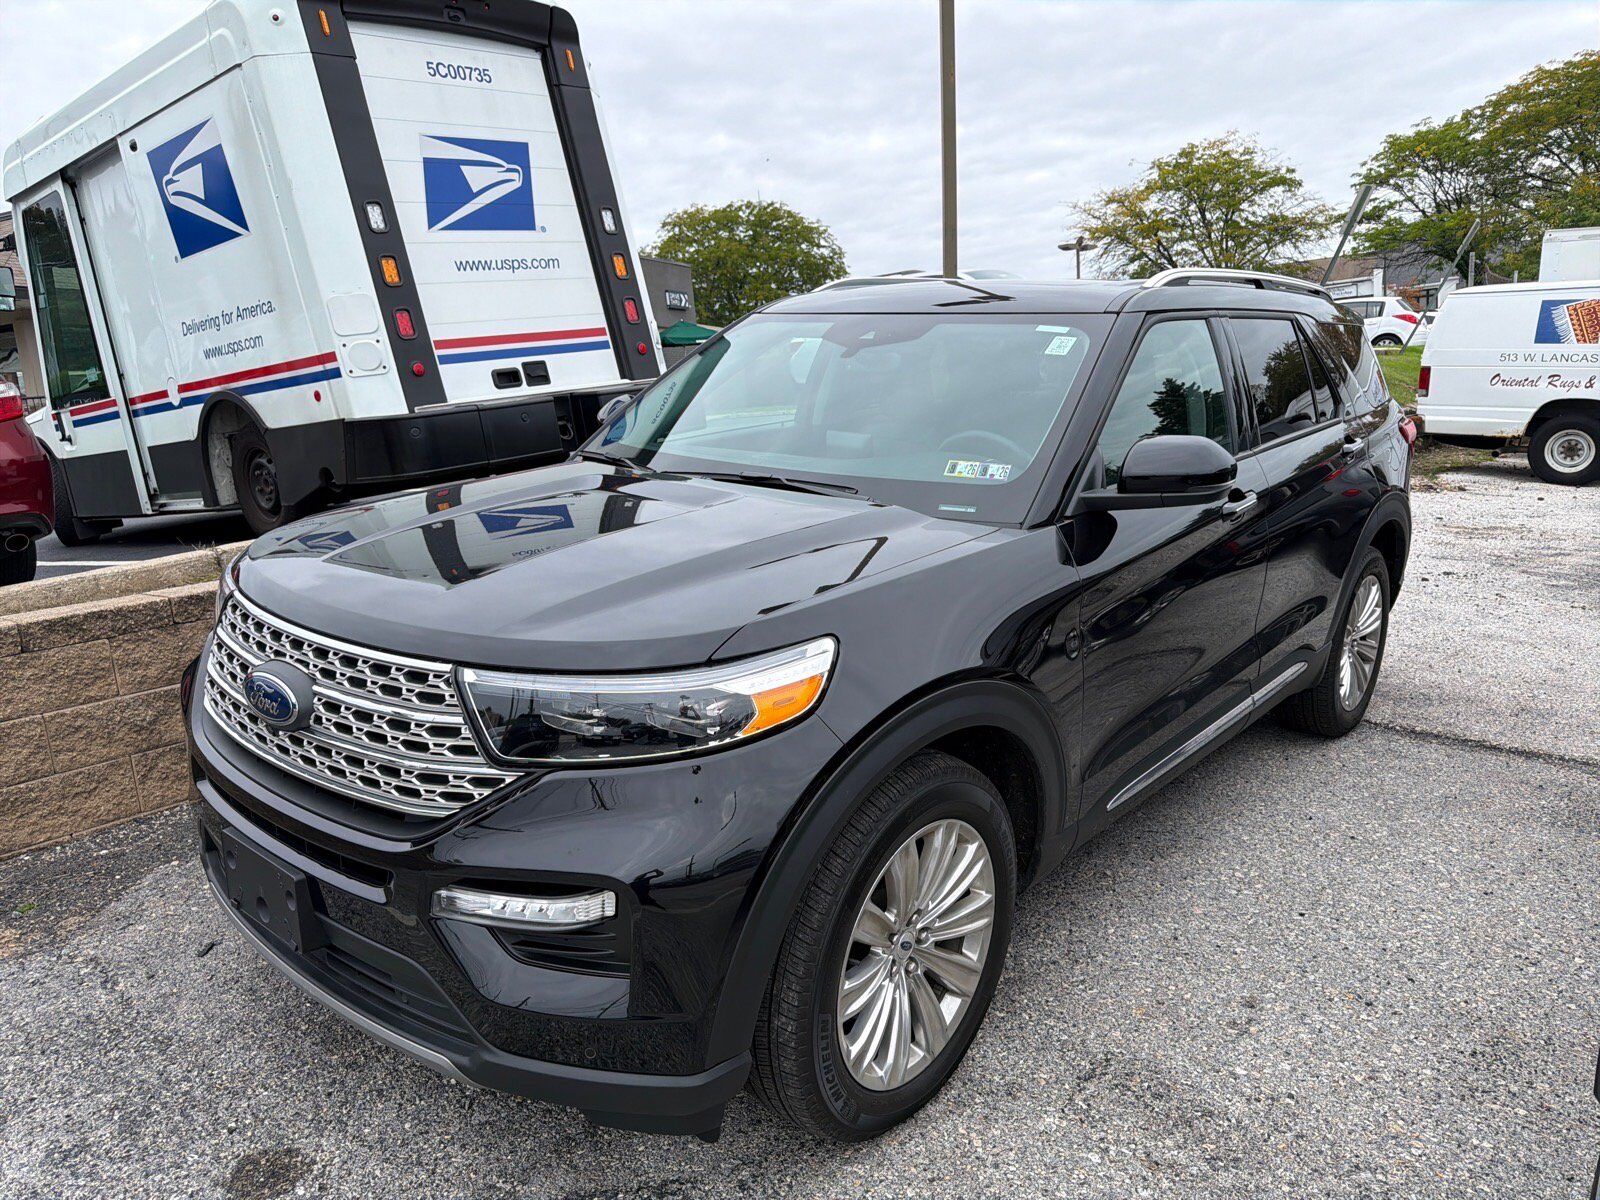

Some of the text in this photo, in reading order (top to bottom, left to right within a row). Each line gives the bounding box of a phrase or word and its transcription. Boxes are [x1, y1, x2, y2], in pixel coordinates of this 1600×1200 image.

[426, 61, 493, 84] 5C00735
[454, 257, 561, 273] www.usps.com
[181, 314, 221, 337] Delivering
[221, 309, 234, 326] for
[203, 334, 264, 360] www.usps.com
[1499, 352, 1599, 363] 513 W. LANCAS
[1489, 372, 1597, 393] Oriental Rugs &
[250, 681, 281, 716] Ford
[820, 1020, 845, 1103] MICHELIN
